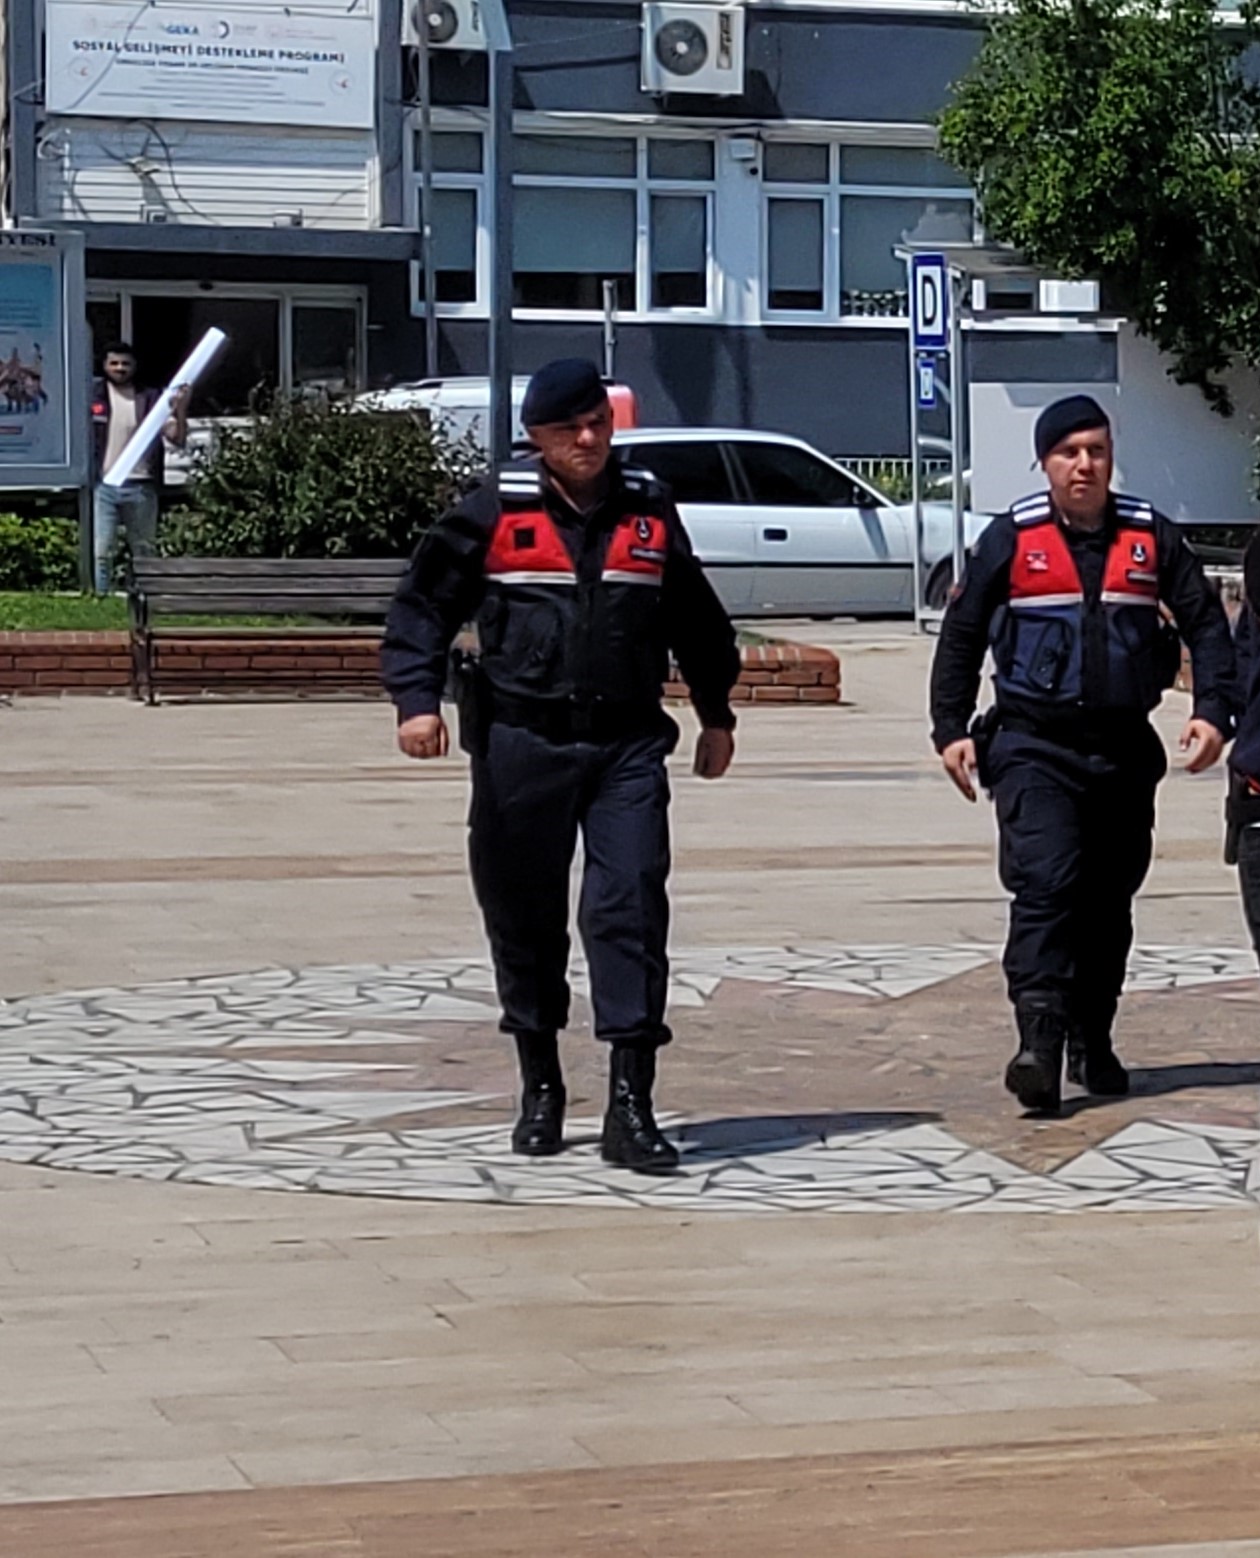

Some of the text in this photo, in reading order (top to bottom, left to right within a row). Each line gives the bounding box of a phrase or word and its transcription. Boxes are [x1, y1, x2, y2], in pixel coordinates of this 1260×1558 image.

[73, 40, 121, 53] SOSYAL
[197, 46, 274, 59] DESTEKLEME
[922, 274, 937, 327] D
